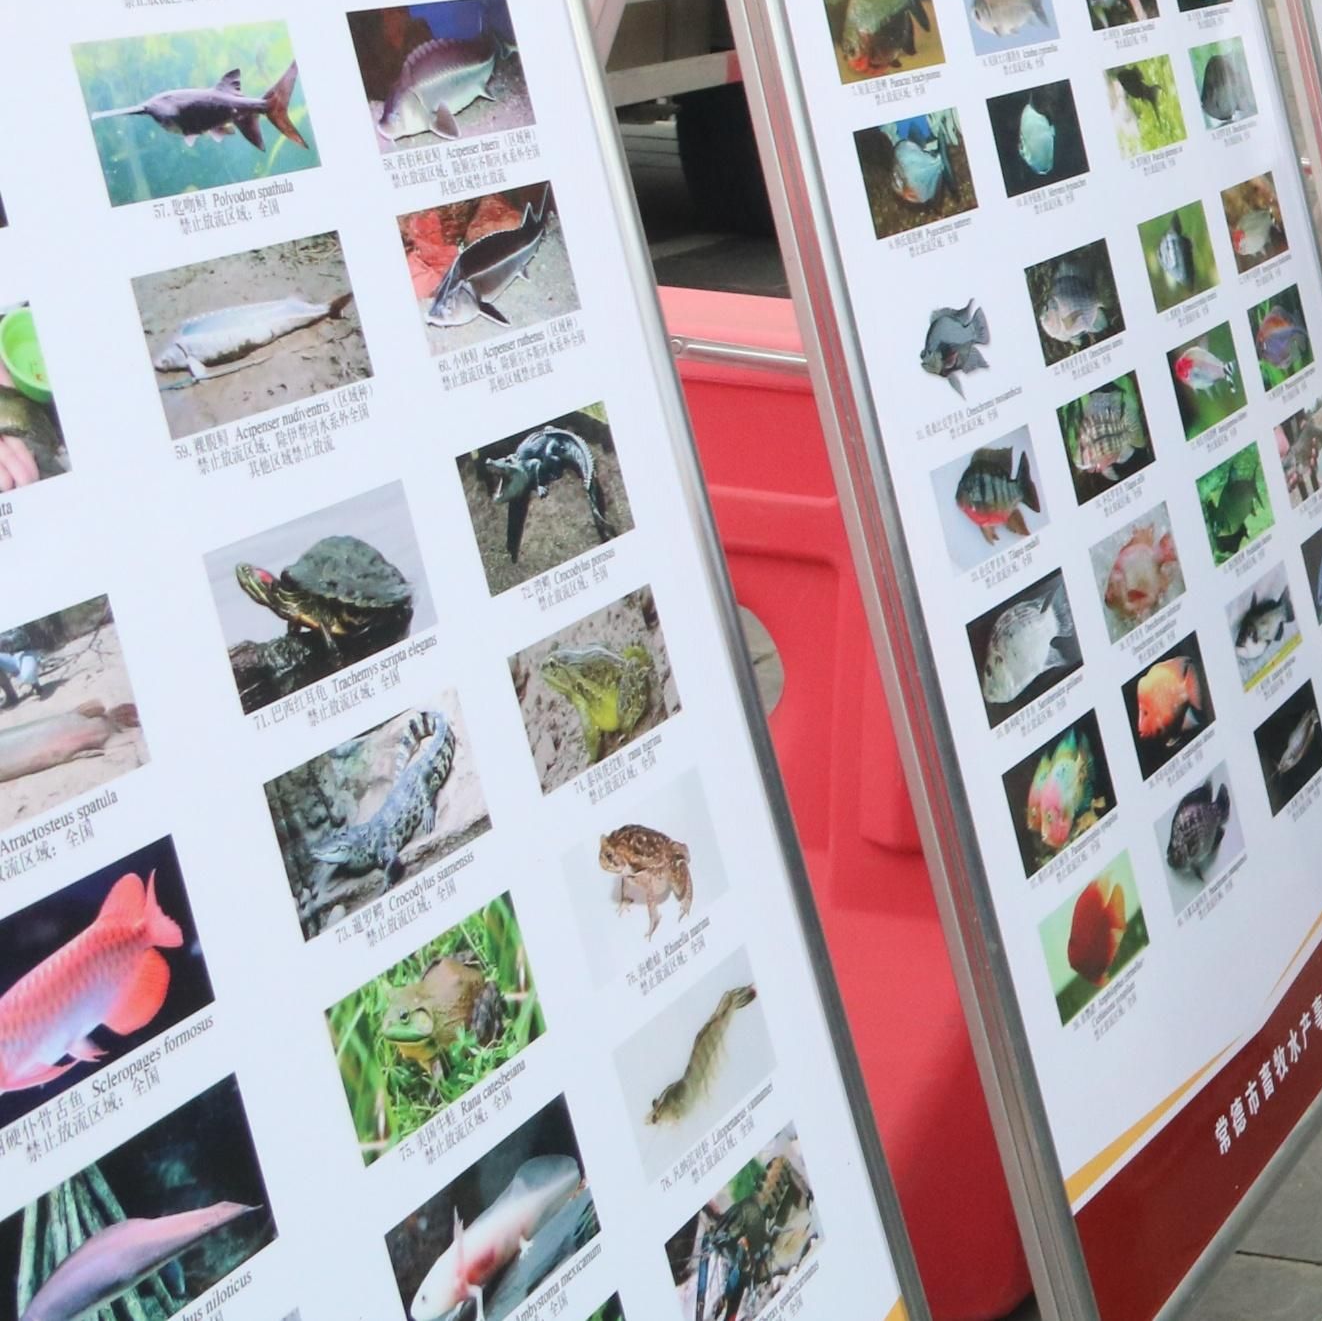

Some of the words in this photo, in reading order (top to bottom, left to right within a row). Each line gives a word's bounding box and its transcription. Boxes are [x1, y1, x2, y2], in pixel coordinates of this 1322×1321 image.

[236, 416, 281, 441] Acipenser
[332, 661, 379, 694] Trachemys
[77, 788, 118, 819] spatula
[0, 817, 95, 881] 流区域：全国
[388, 875, 436, 911] Crocodylus
[0, 1090, 82, 1156] 硬仆骨舌鱼
[92, 1045, 161, 1098] Scleropages
[164, 1014, 214, 1055] formosus
[460, 1092, 482, 1116] Rana
[560, 1243, 602, 1288] mexicanum
[205, 1270, 253, 1315] niloticus
